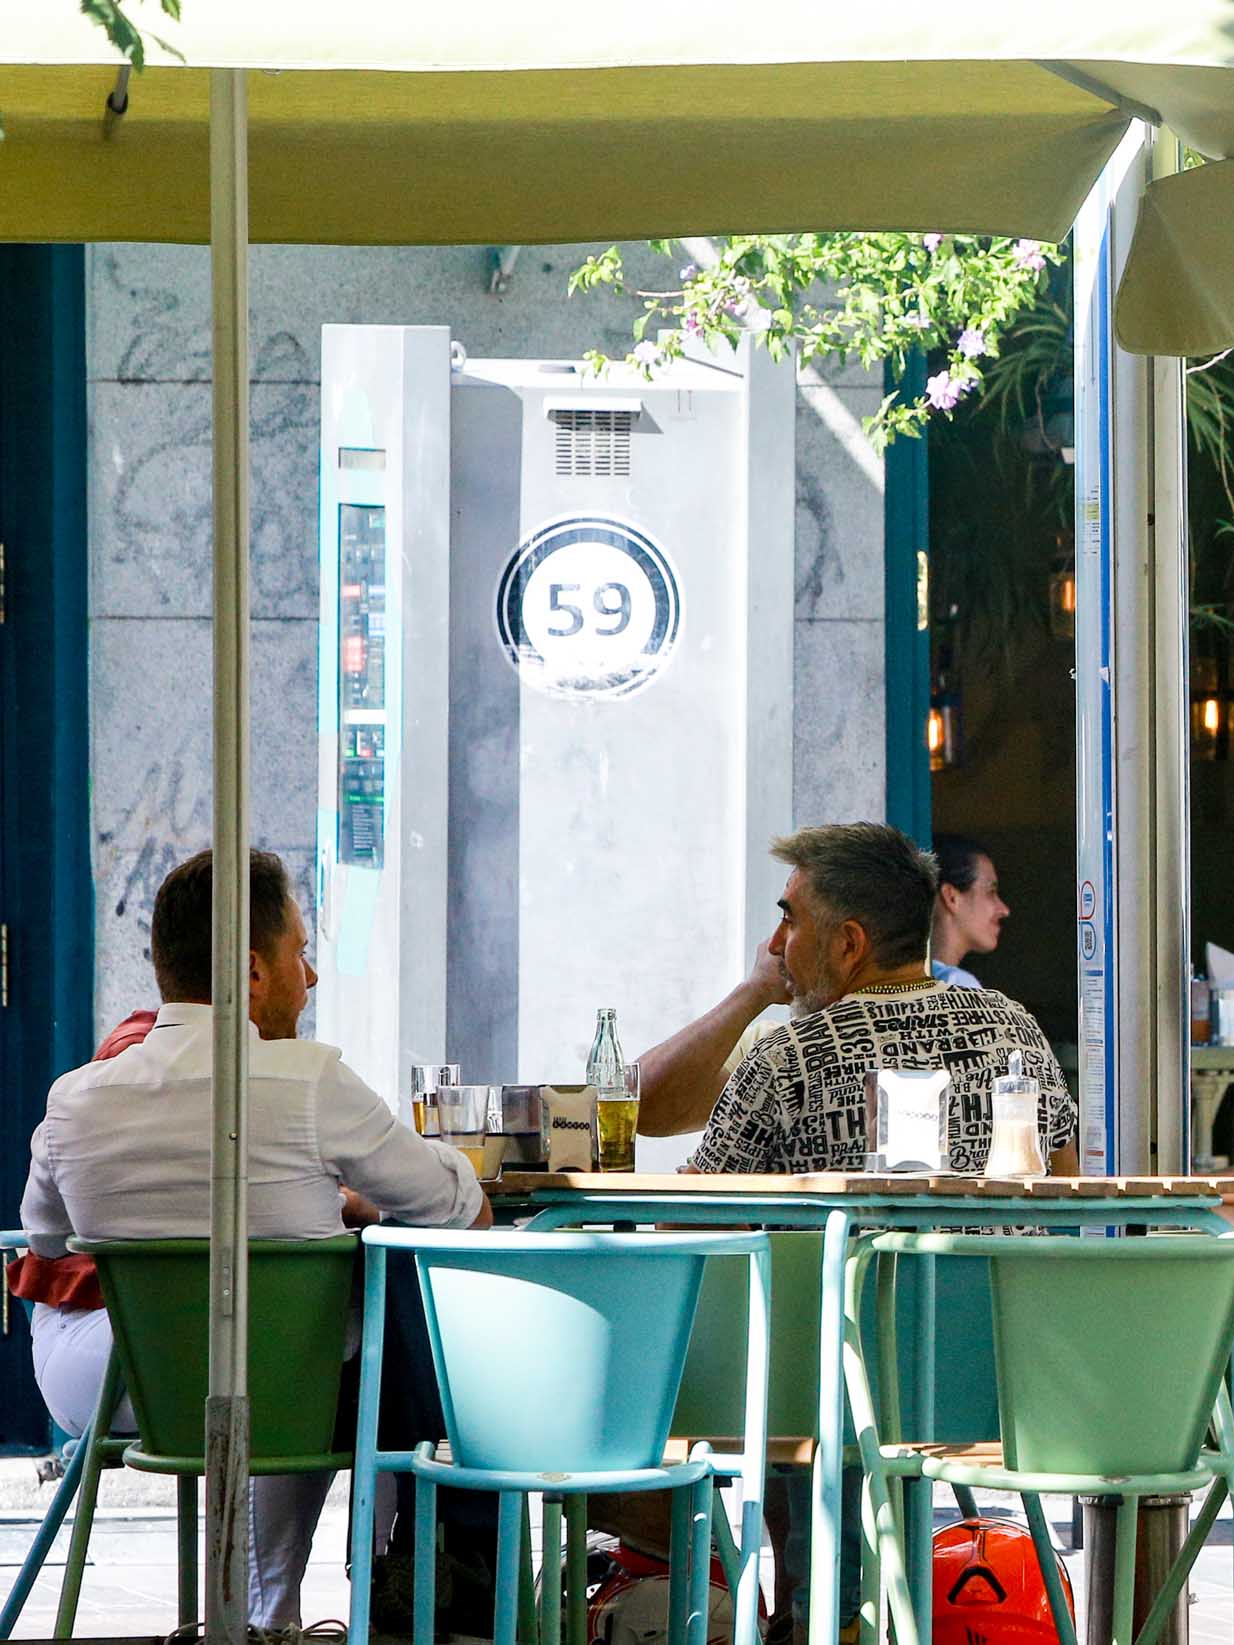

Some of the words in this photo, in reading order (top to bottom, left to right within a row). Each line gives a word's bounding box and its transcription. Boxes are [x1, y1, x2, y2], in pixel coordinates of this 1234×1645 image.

[548, 582, 632, 637] 59
[868, 1002, 924, 1019] STRIPES
[951, 1010, 996, 1027] THREE
[791, 1013, 839, 1072] BRAN
[900, 1028, 953, 1040] WITH
[881, 1036, 968, 1056] BRAND
[948, 1054, 995, 1074] WITH
[807, 1071, 824, 1113] STRIPES
